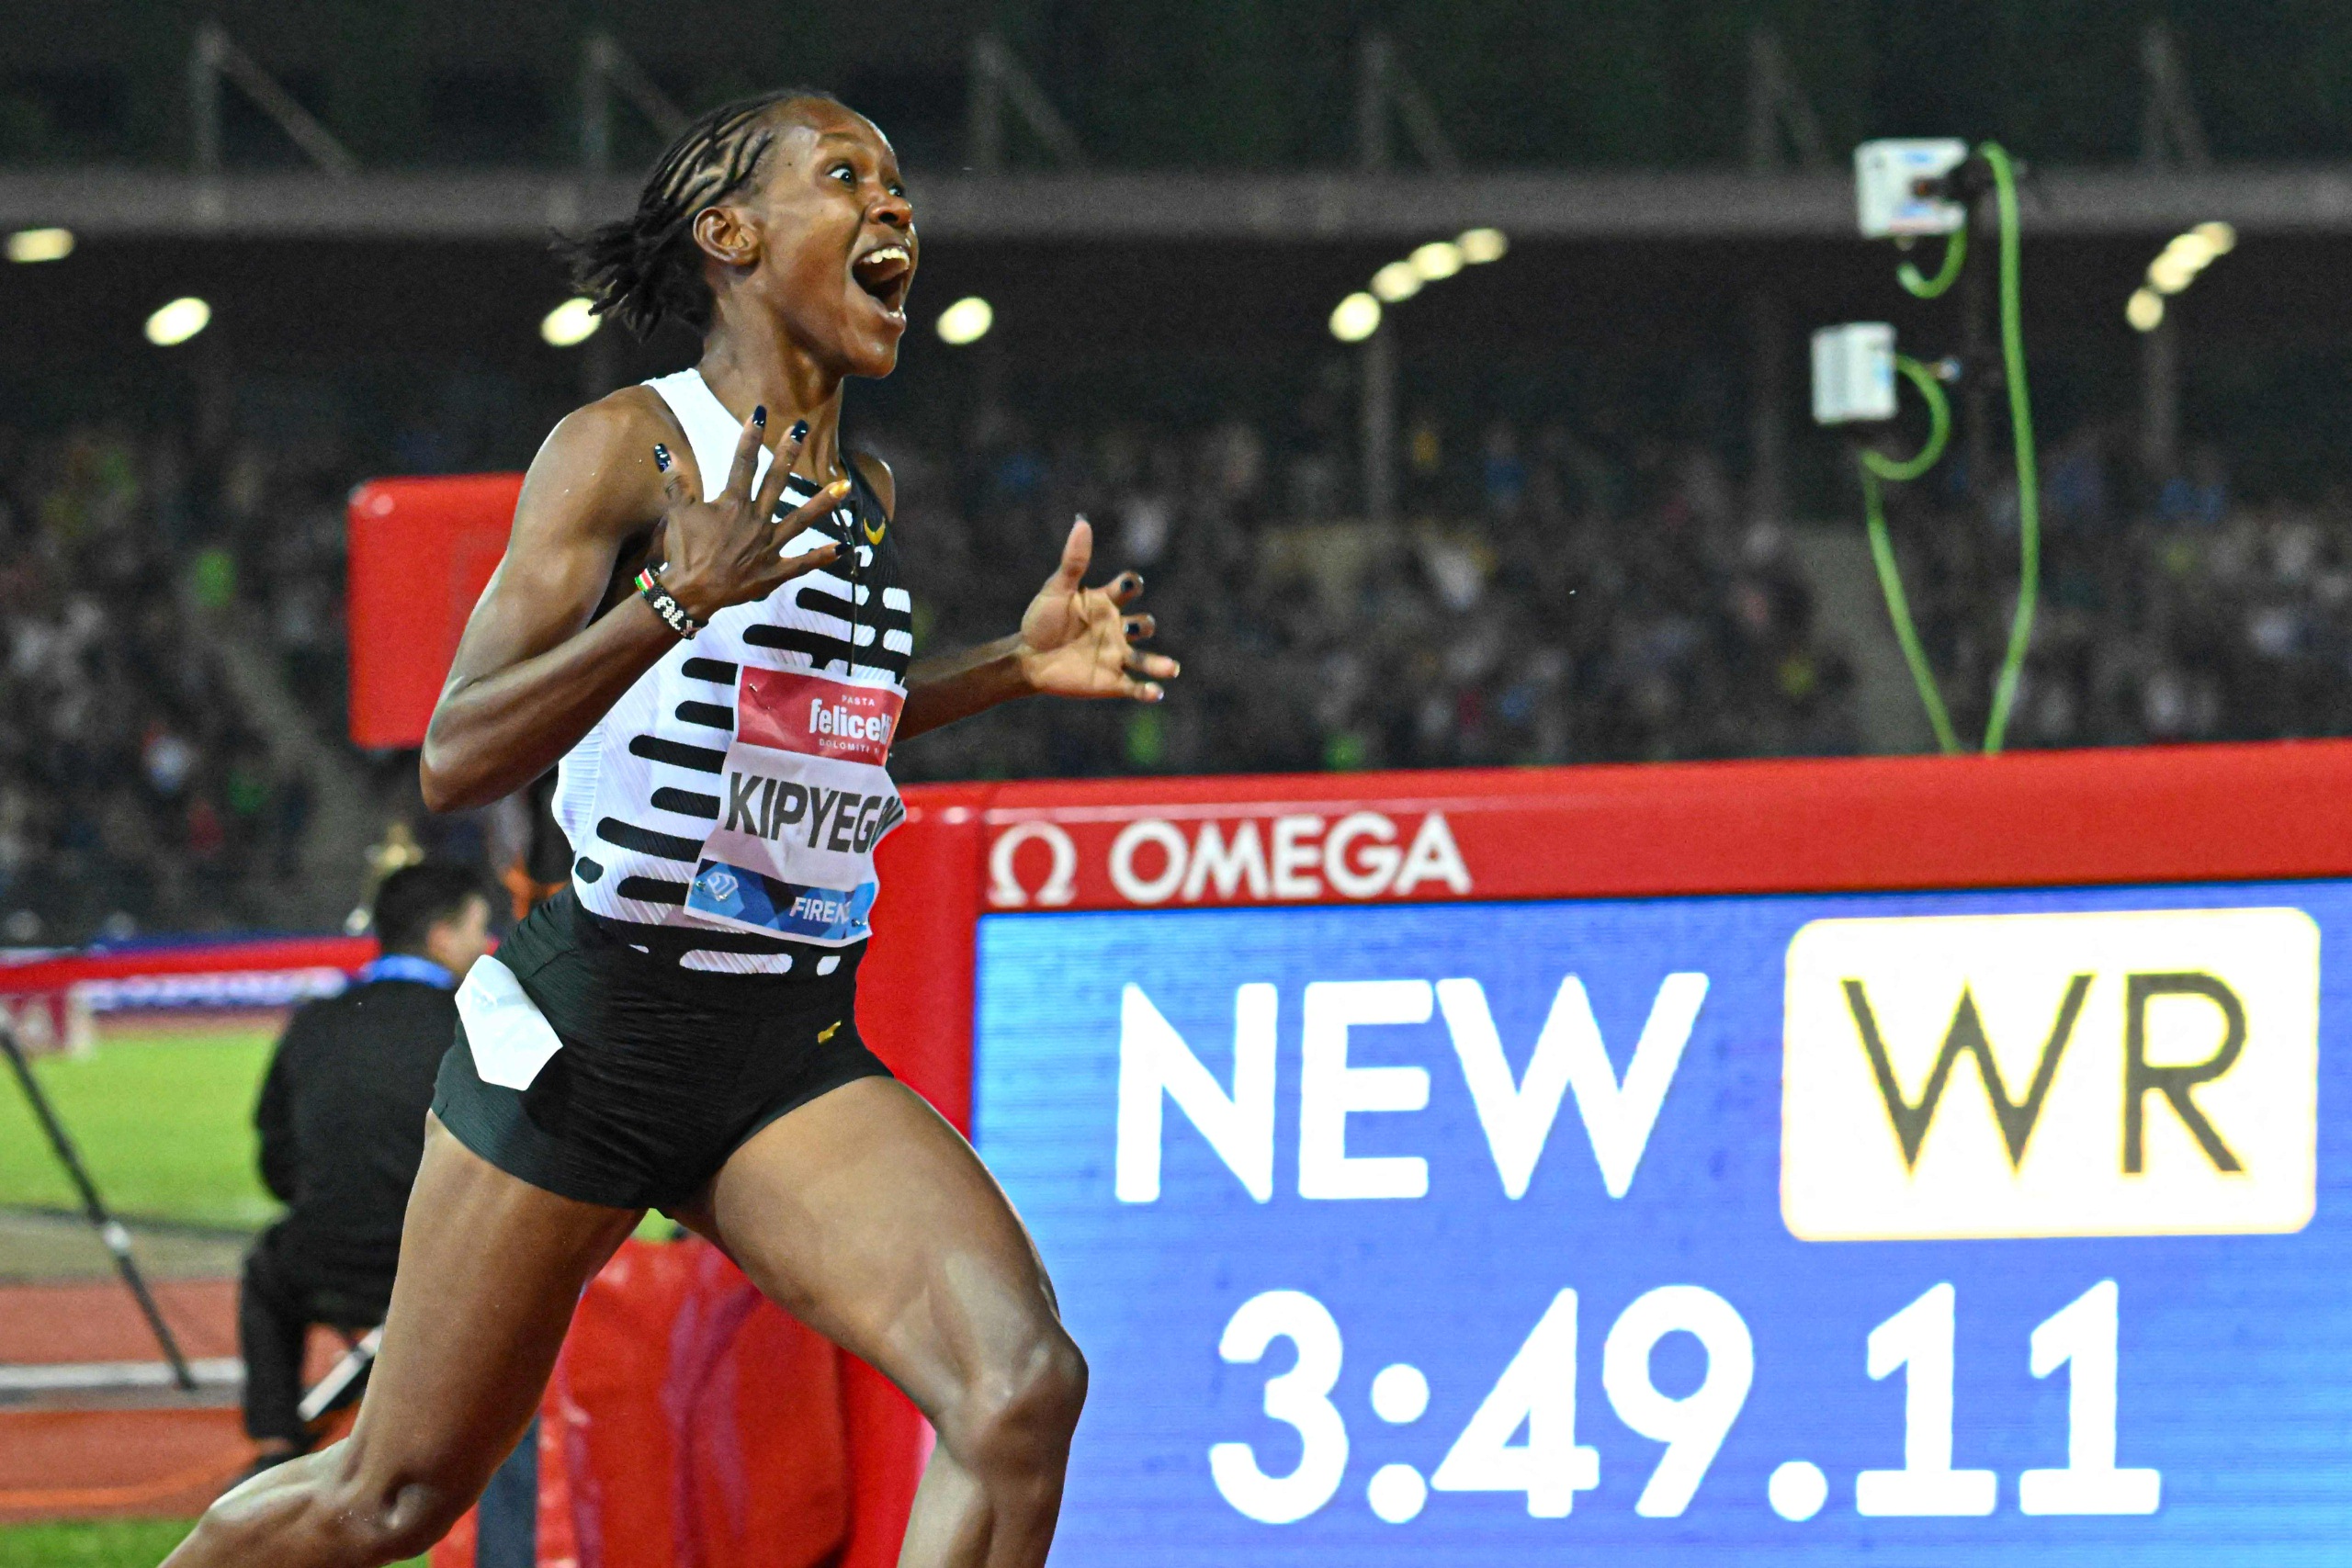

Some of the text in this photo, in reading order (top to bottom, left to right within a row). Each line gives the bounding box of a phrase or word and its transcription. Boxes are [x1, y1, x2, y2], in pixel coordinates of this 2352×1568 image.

[842, 694, 875, 706] PASTA
[819, 738, 870, 753] DOLOMITI
[1109, 811, 1472, 903] OMEGA
[789, 897, 851, 924] FIREN
[1114, 971, 2247, 1203] NEW WR
[1209, 1279, 2163, 1525] 3:49.11
